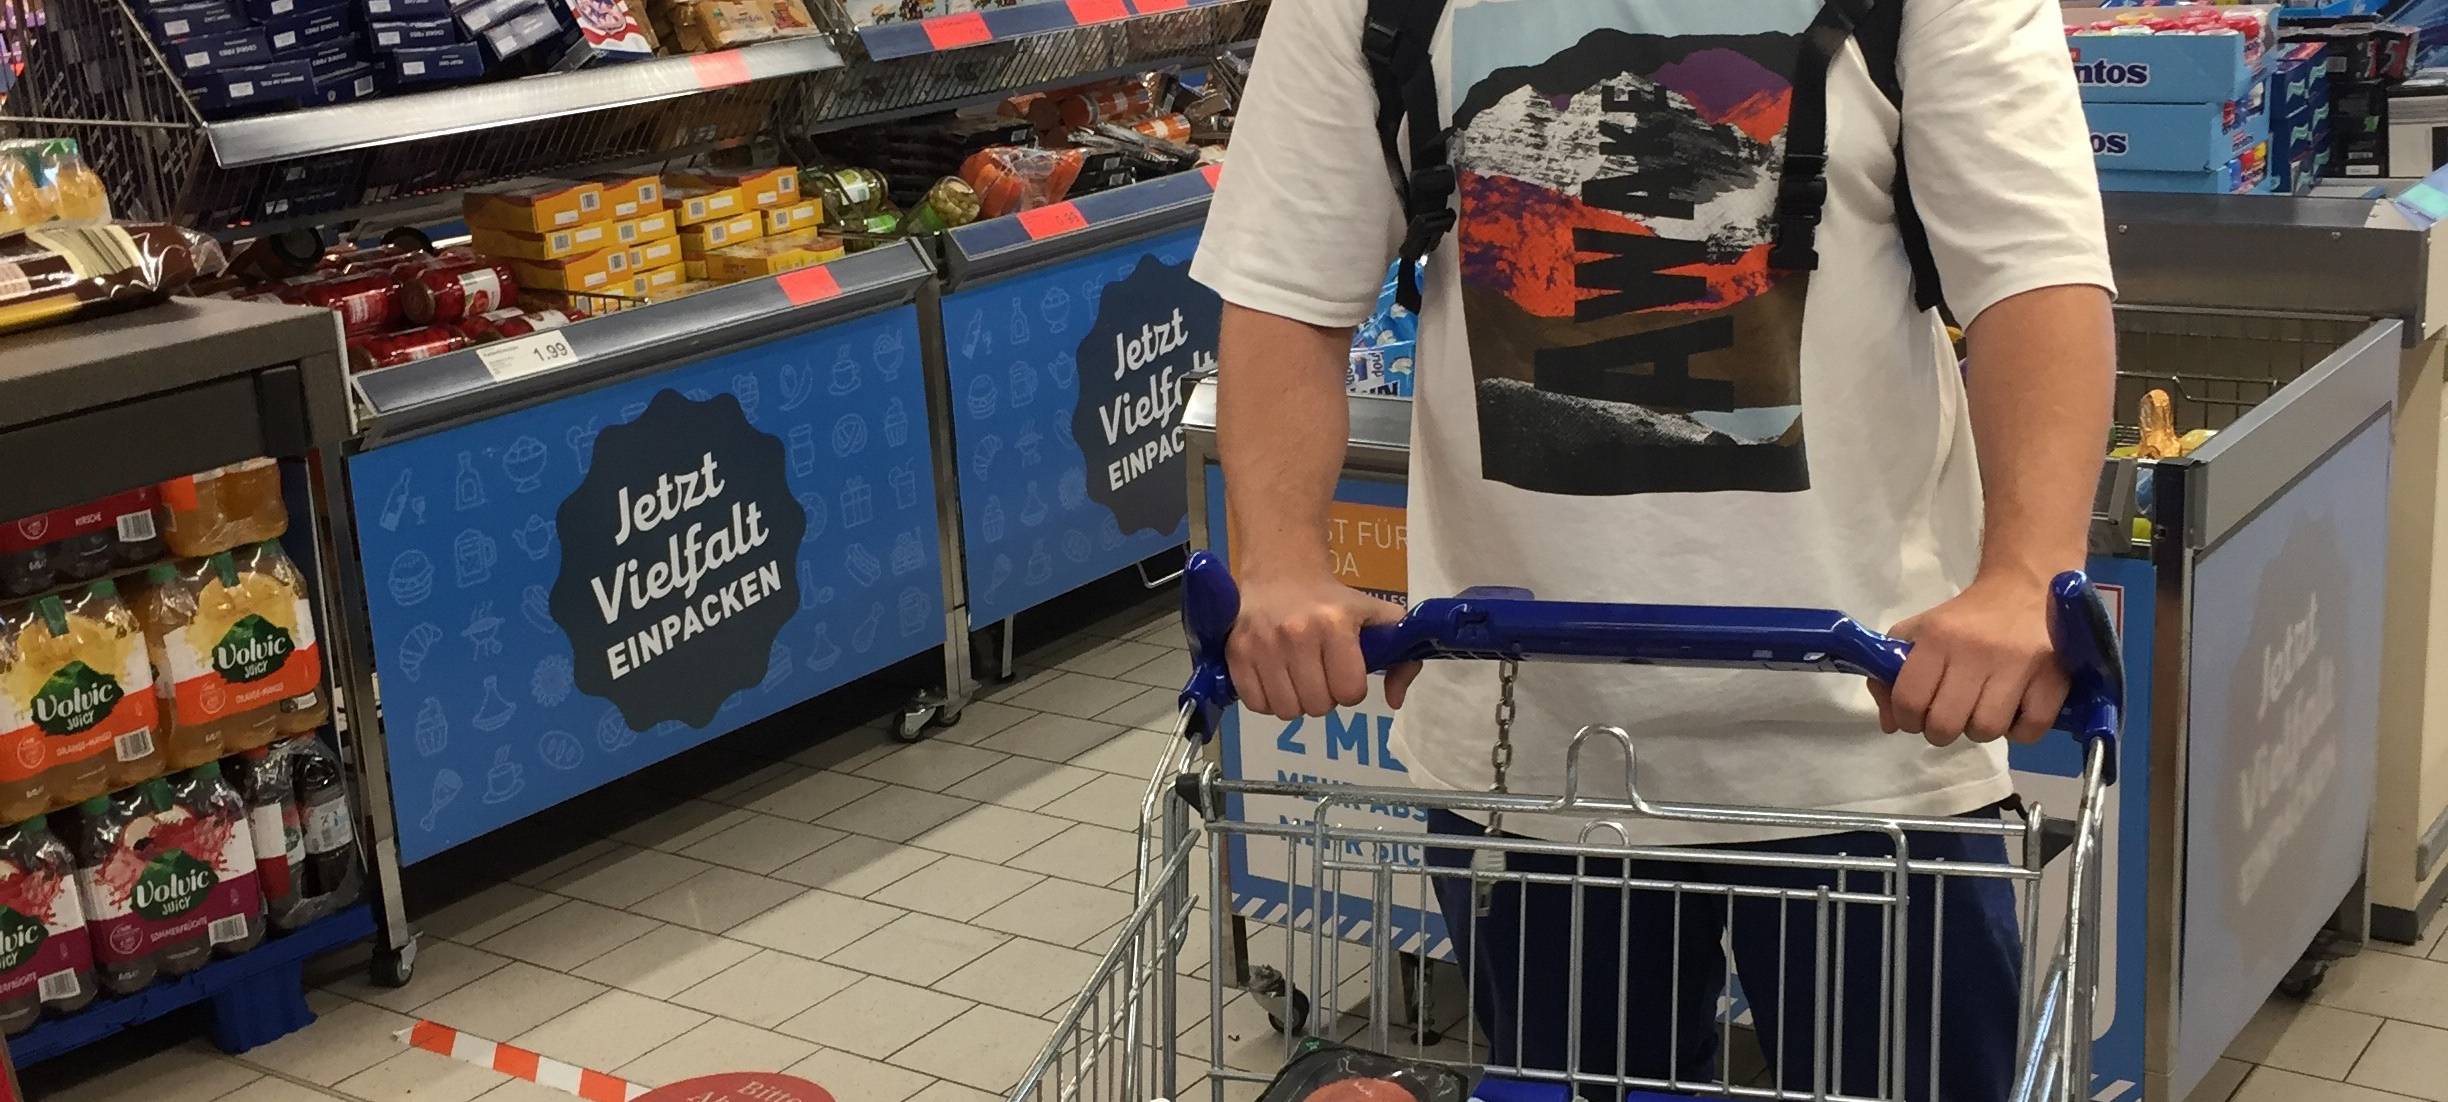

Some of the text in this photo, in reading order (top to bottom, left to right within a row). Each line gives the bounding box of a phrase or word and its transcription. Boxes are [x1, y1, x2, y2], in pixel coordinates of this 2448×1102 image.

[2073, 59, 2149, 85] ntos
[1534, 84, 1734, 412] AWAKE
[533, 341, 569, 362] 1.99
[1114, 307, 1188, 381] Jetzt
[1099, 350, 1217, 446] Vielflt
[614, 451, 725, 546] Jetzt
[1358, 518, 1408, 550] FÜR
[590, 501, 769, 625] Vielfalt
[606, 560, 782, 680] EINPACKEN
[217, 634, 286, 669] Volvic
[36, 683, 113, 722] Volvic
[136, 869, 210, 908] Volvic
